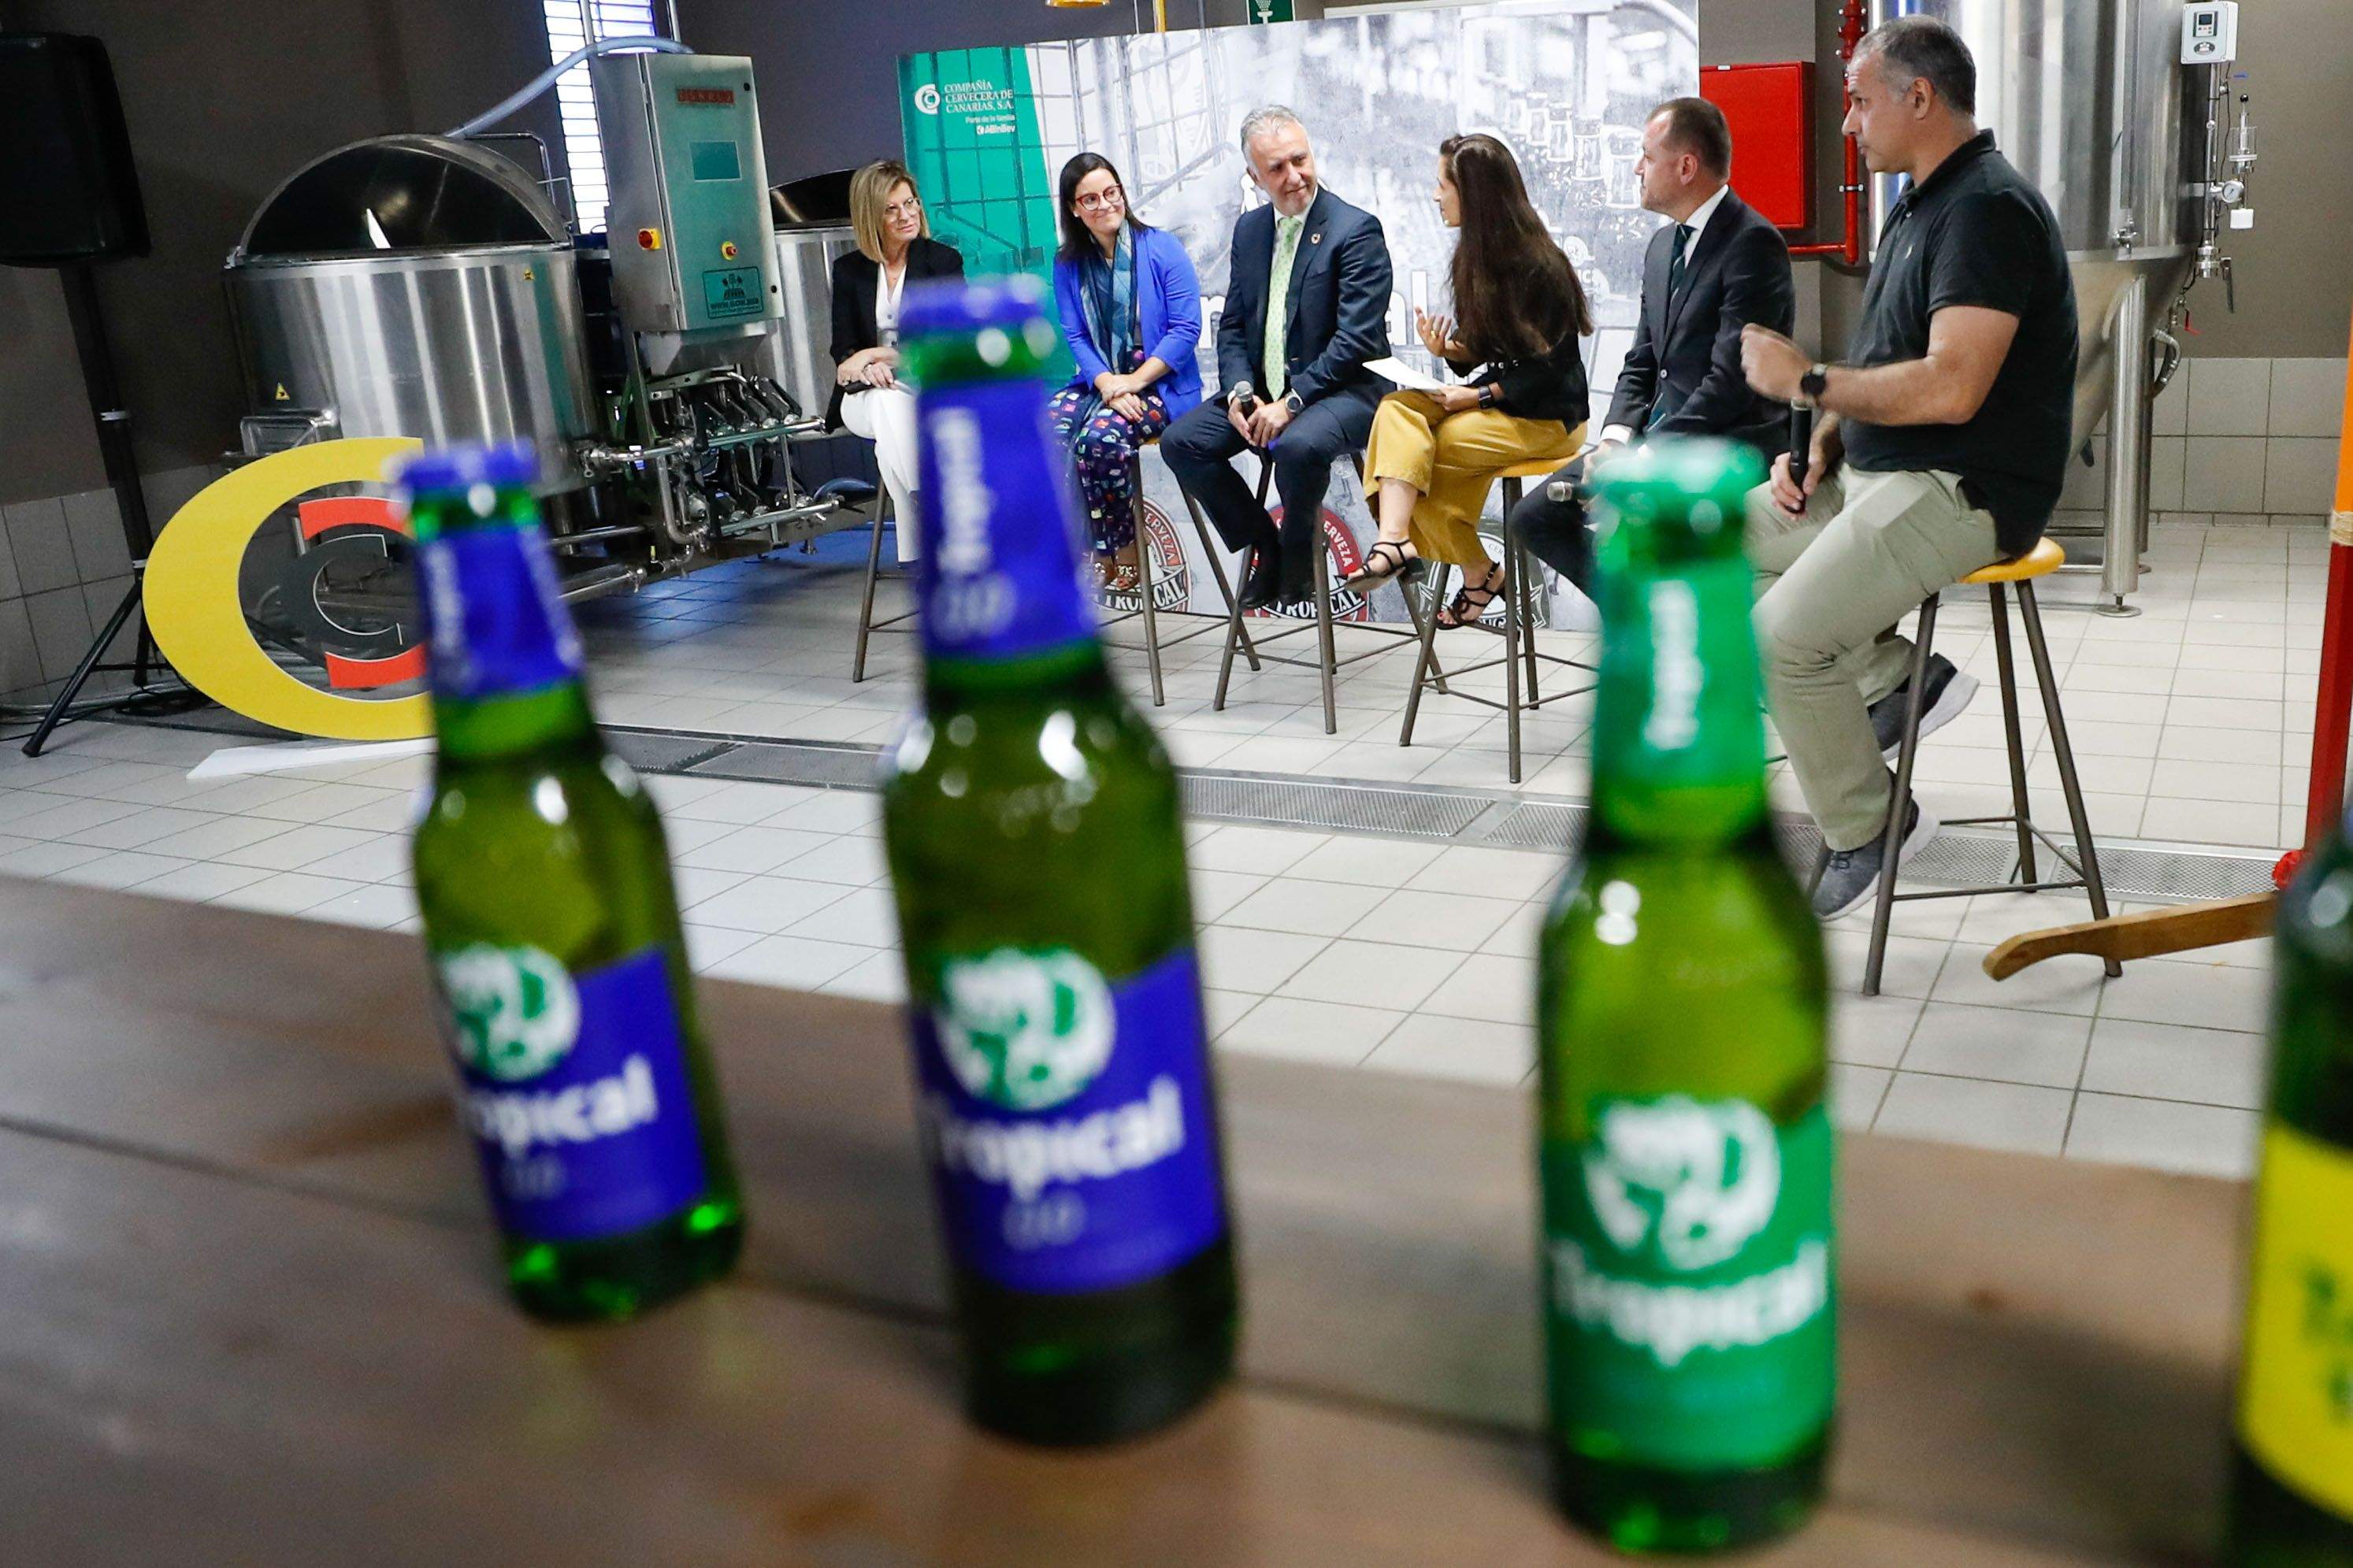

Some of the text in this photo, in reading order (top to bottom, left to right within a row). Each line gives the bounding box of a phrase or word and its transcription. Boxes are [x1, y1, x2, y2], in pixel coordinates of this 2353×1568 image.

[945, 80, 993, 93] COMPAÑÍA
[945, 89, 1014, 103] CERVECERA DE
[946, 99, 1015, 113] CANARIAS, S.A.
[1144, 509, 1175, 560] ERVEZA
[1323, 521, 1353, 567] ERVEZA
[1104, 577, 1186, 611] TROCAL
[1275, 591, 1362, 618] ROPCAL
